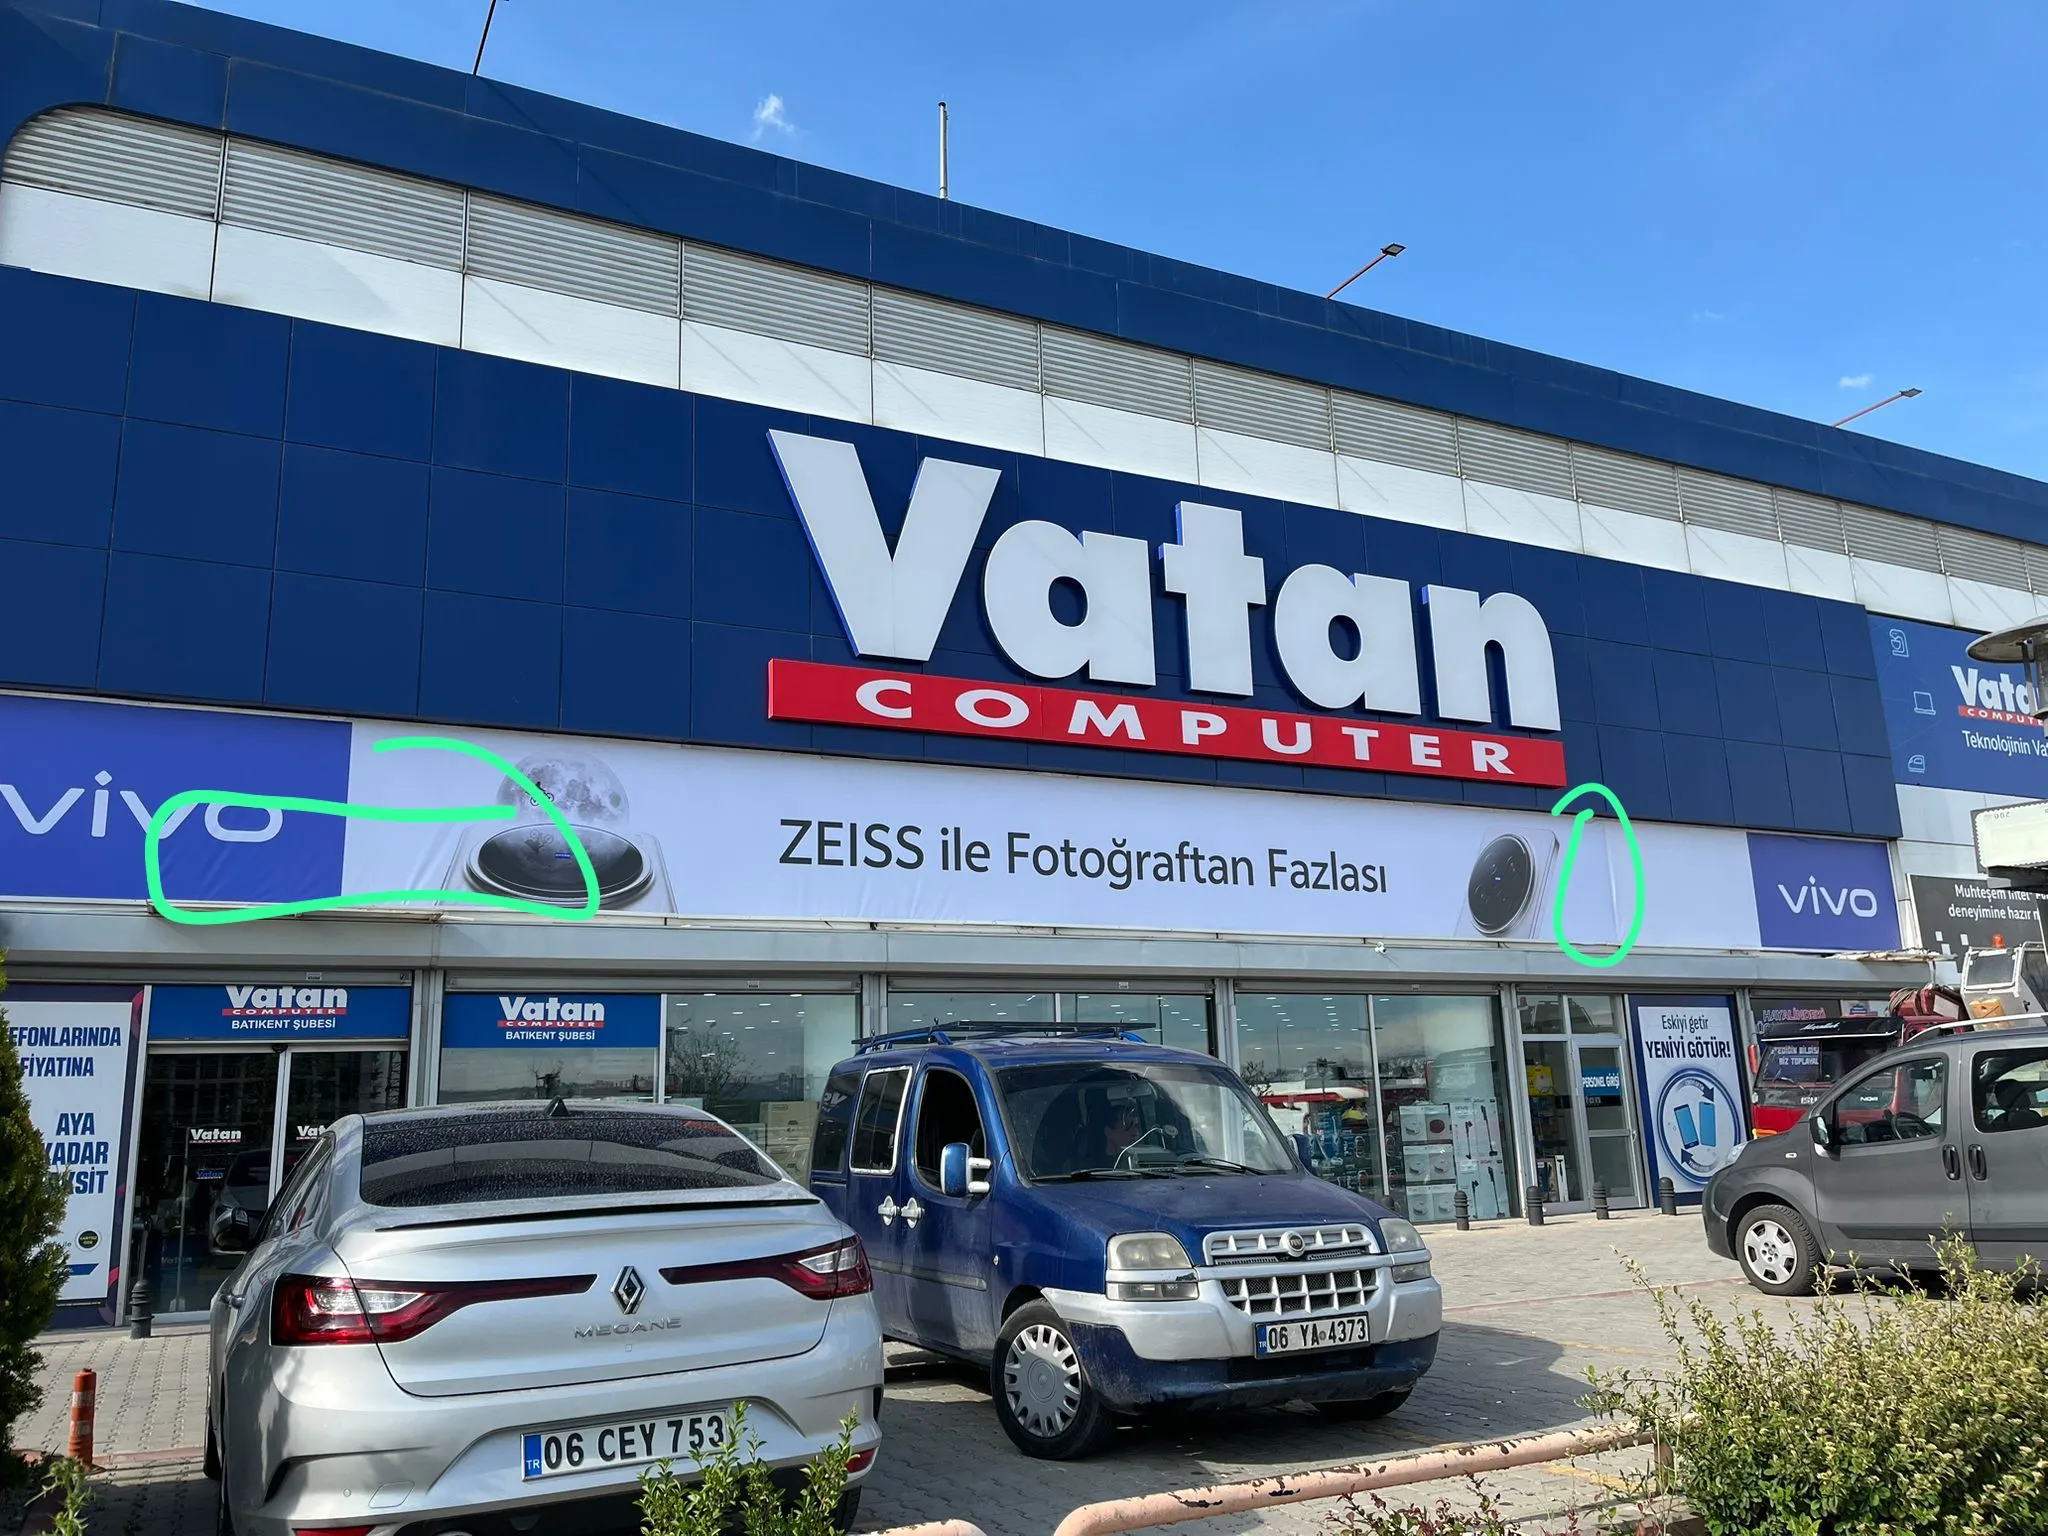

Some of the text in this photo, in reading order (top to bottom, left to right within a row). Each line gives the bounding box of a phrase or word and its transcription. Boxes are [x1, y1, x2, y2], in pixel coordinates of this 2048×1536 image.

[767, 428, 1561, 731] Vatan
[1950, 665, 2039, 715] Vata
[855, 678, 1516, 775] COMPUTER
[1967, 708, 2044, 726] COMPUTE
[1962, 730, 2031, 757] Teknolojinin
[0, 770, 284, 843] vivo
[778, 818, 1389, 893] ZEISS ile Fotoğraftan Fazlası
[1778, 875, 1877, 918] vivo
[1954, 883, 2007, 902] Muhteşem
[1949, 903, 2007, 921] deneyimine
[2007, 906, 2031, 920] hazır
[226, 986, 347, 1009] Vatan
[499, 996, 605, 1021] Vatan
[232, 1017, 336, 1031] BATIKENT ŞUBESİ
[1661, 1014, 1709, 1034] Eskiyi getir
[8, 1026, 121, 1047] EFONLARINDA
[505, 1030, 595, 1042] BATIKENT ŞUBESİ
[1645, 1035, 1731, 1059] YENİYİ GÖTÜR!
[56, 1113, 95, 1136] AYA
[190, 1128, 241, 1140] Vatan
[297, 1125, 328, 1137] Vat
[573, 1317, 681, 1340] MEGANE
[1268, 1318, 1366, 1350] 06 YA 4373
[543, 1415, 725, 1470] 06 CEY 753
[526, 1459, 541, 1471] TR
